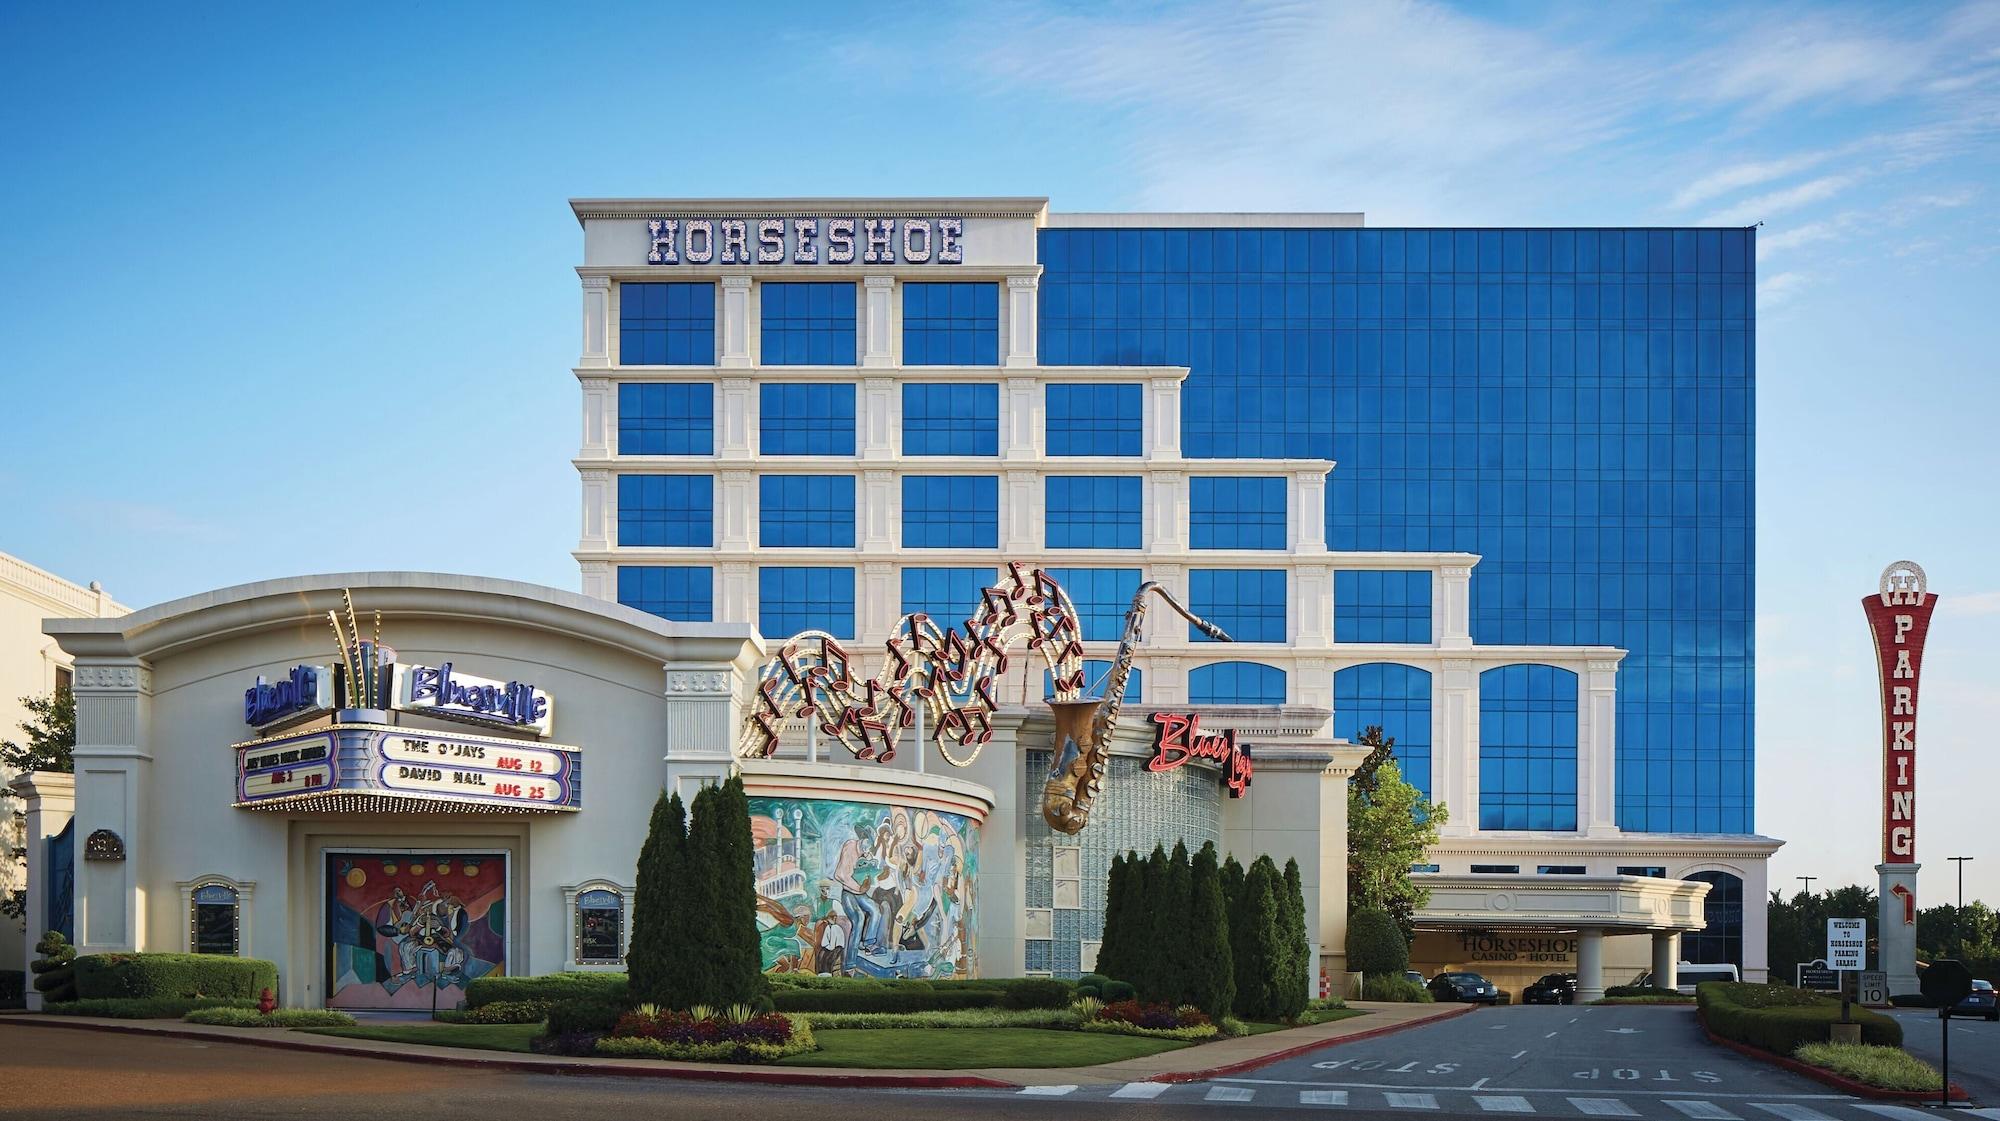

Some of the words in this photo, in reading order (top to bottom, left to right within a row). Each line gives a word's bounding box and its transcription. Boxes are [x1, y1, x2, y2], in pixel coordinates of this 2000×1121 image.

[648, 219, 963, 264] HORSESHOE
[411, 662, 546, 724] Bluesville
[1149, 712, 1231, 771] Blues
[1892, 614, 1914, 856] PARKING
[403, 739, 429, 753] THE
[438, 743, 486, 760] O'JAYS
[496, 756, 523, 770] AUG
[530, 760, 543, 773] 12
[399, 766, 442, 782] DAVID
[453, 771, 486, 786] NAIL
[494, 783, 521, 797] AUG
[529, 786, 545, 799] 25
[1463, 939, 1577, 953] HORSESHOE
[1830, 940, 1862, 948] HORSESHOE
[1471, 952, 1517, 961] CASINO
[1530, 953, 1569, 962] HOTEL
[1863, 989, 1882, 1002] 10
[1311, 1058, 1461, 1075] STOP
[1572, 1068, 1723, 1083] STOP
